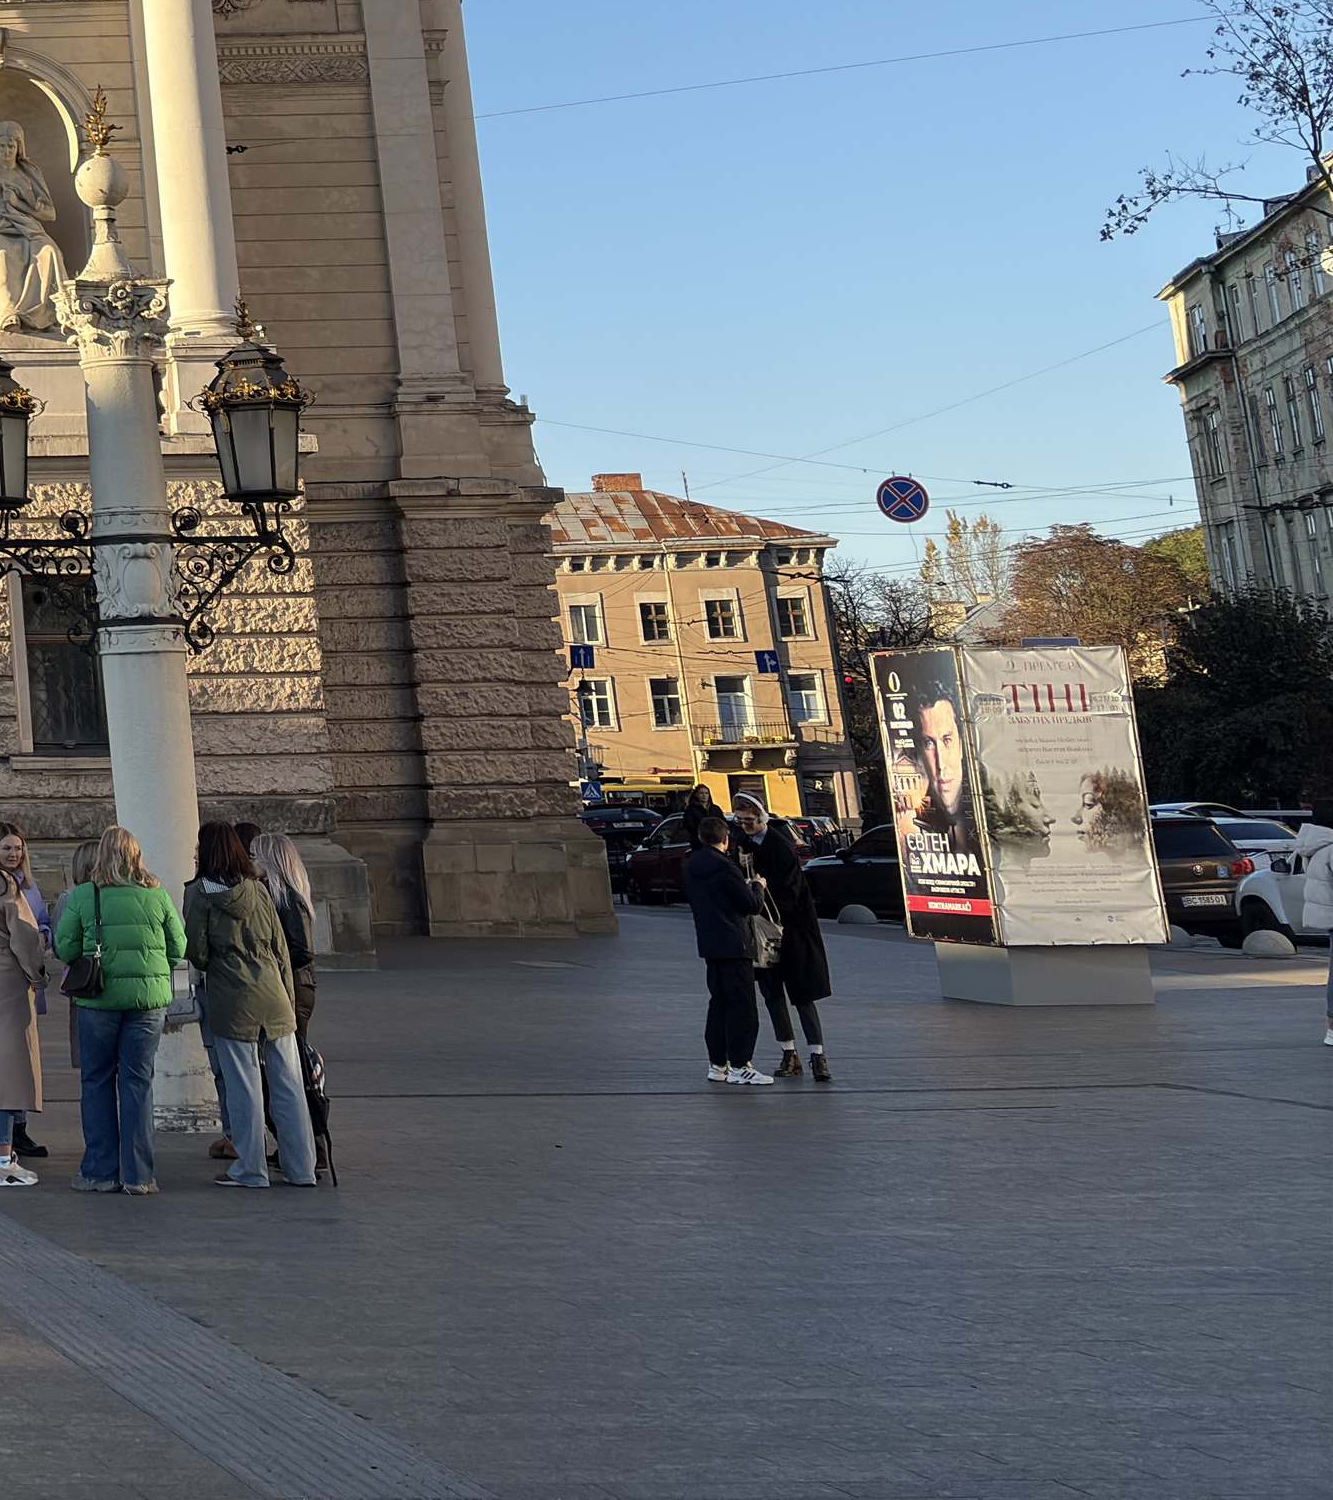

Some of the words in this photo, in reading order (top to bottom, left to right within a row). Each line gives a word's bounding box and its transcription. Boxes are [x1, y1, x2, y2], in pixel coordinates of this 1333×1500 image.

[1001, 682, 1088, 712] ТІНІ
[907, 832, 950, 852] ЄВГЕН
[919, 852, 981, 876] ХМАРА
